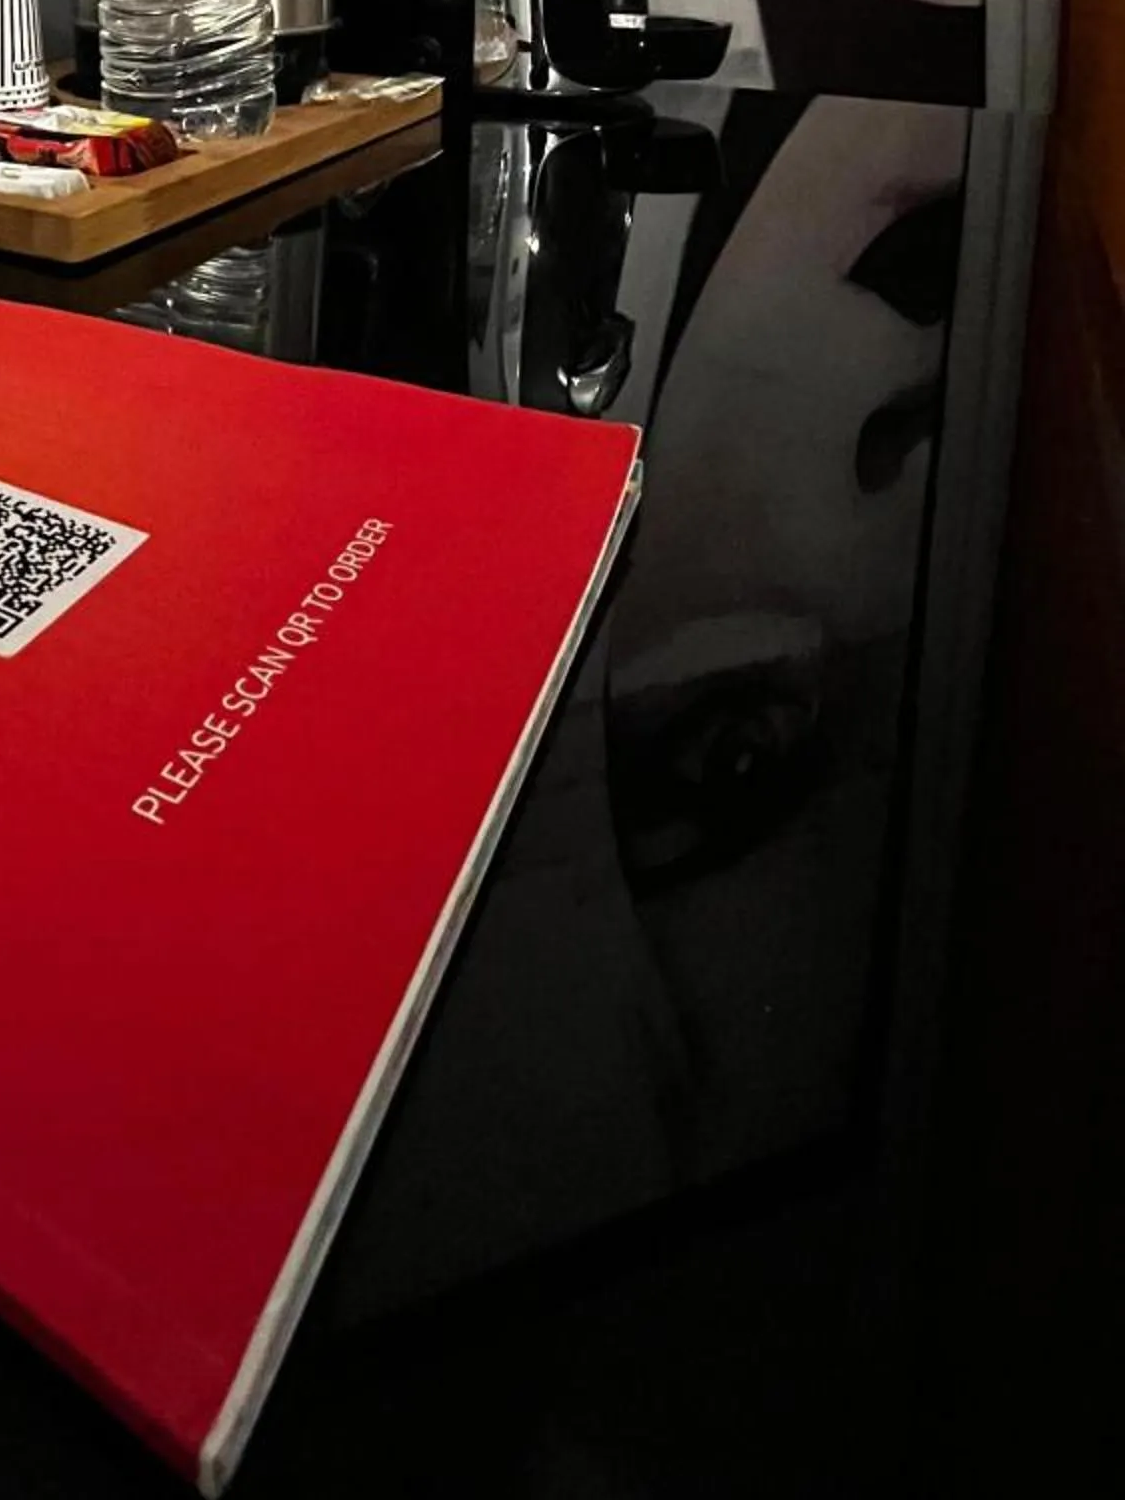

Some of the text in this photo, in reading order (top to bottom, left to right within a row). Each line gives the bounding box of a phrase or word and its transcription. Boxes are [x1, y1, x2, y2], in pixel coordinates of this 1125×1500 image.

[131, 517, 395, 826] PLEASE SCAN QR TO ORDER
